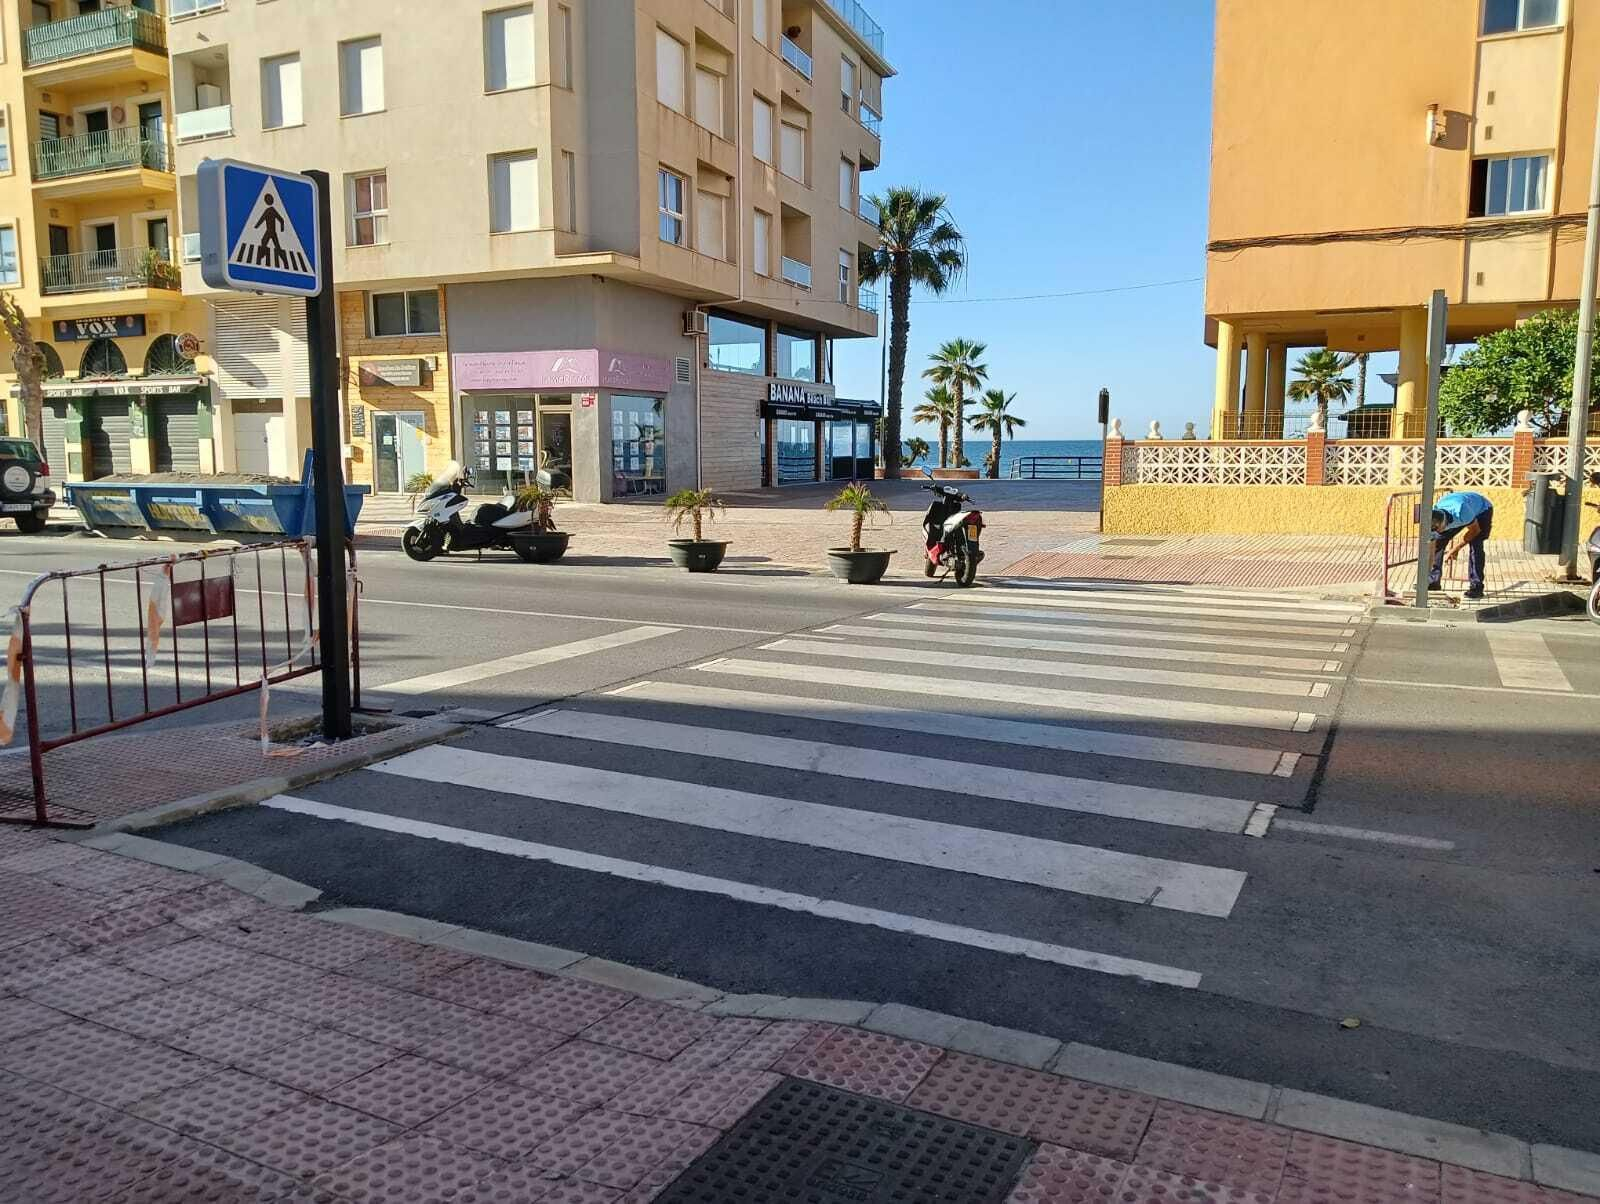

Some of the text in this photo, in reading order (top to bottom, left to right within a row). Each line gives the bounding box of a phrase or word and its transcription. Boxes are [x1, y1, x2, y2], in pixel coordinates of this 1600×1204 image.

[76, 321, 118, 335] VOX
[140, 386, 163, 394] SPORTS
[168, 386, 181, 394] BAR
[770, 384, 805, 404] BANANA
